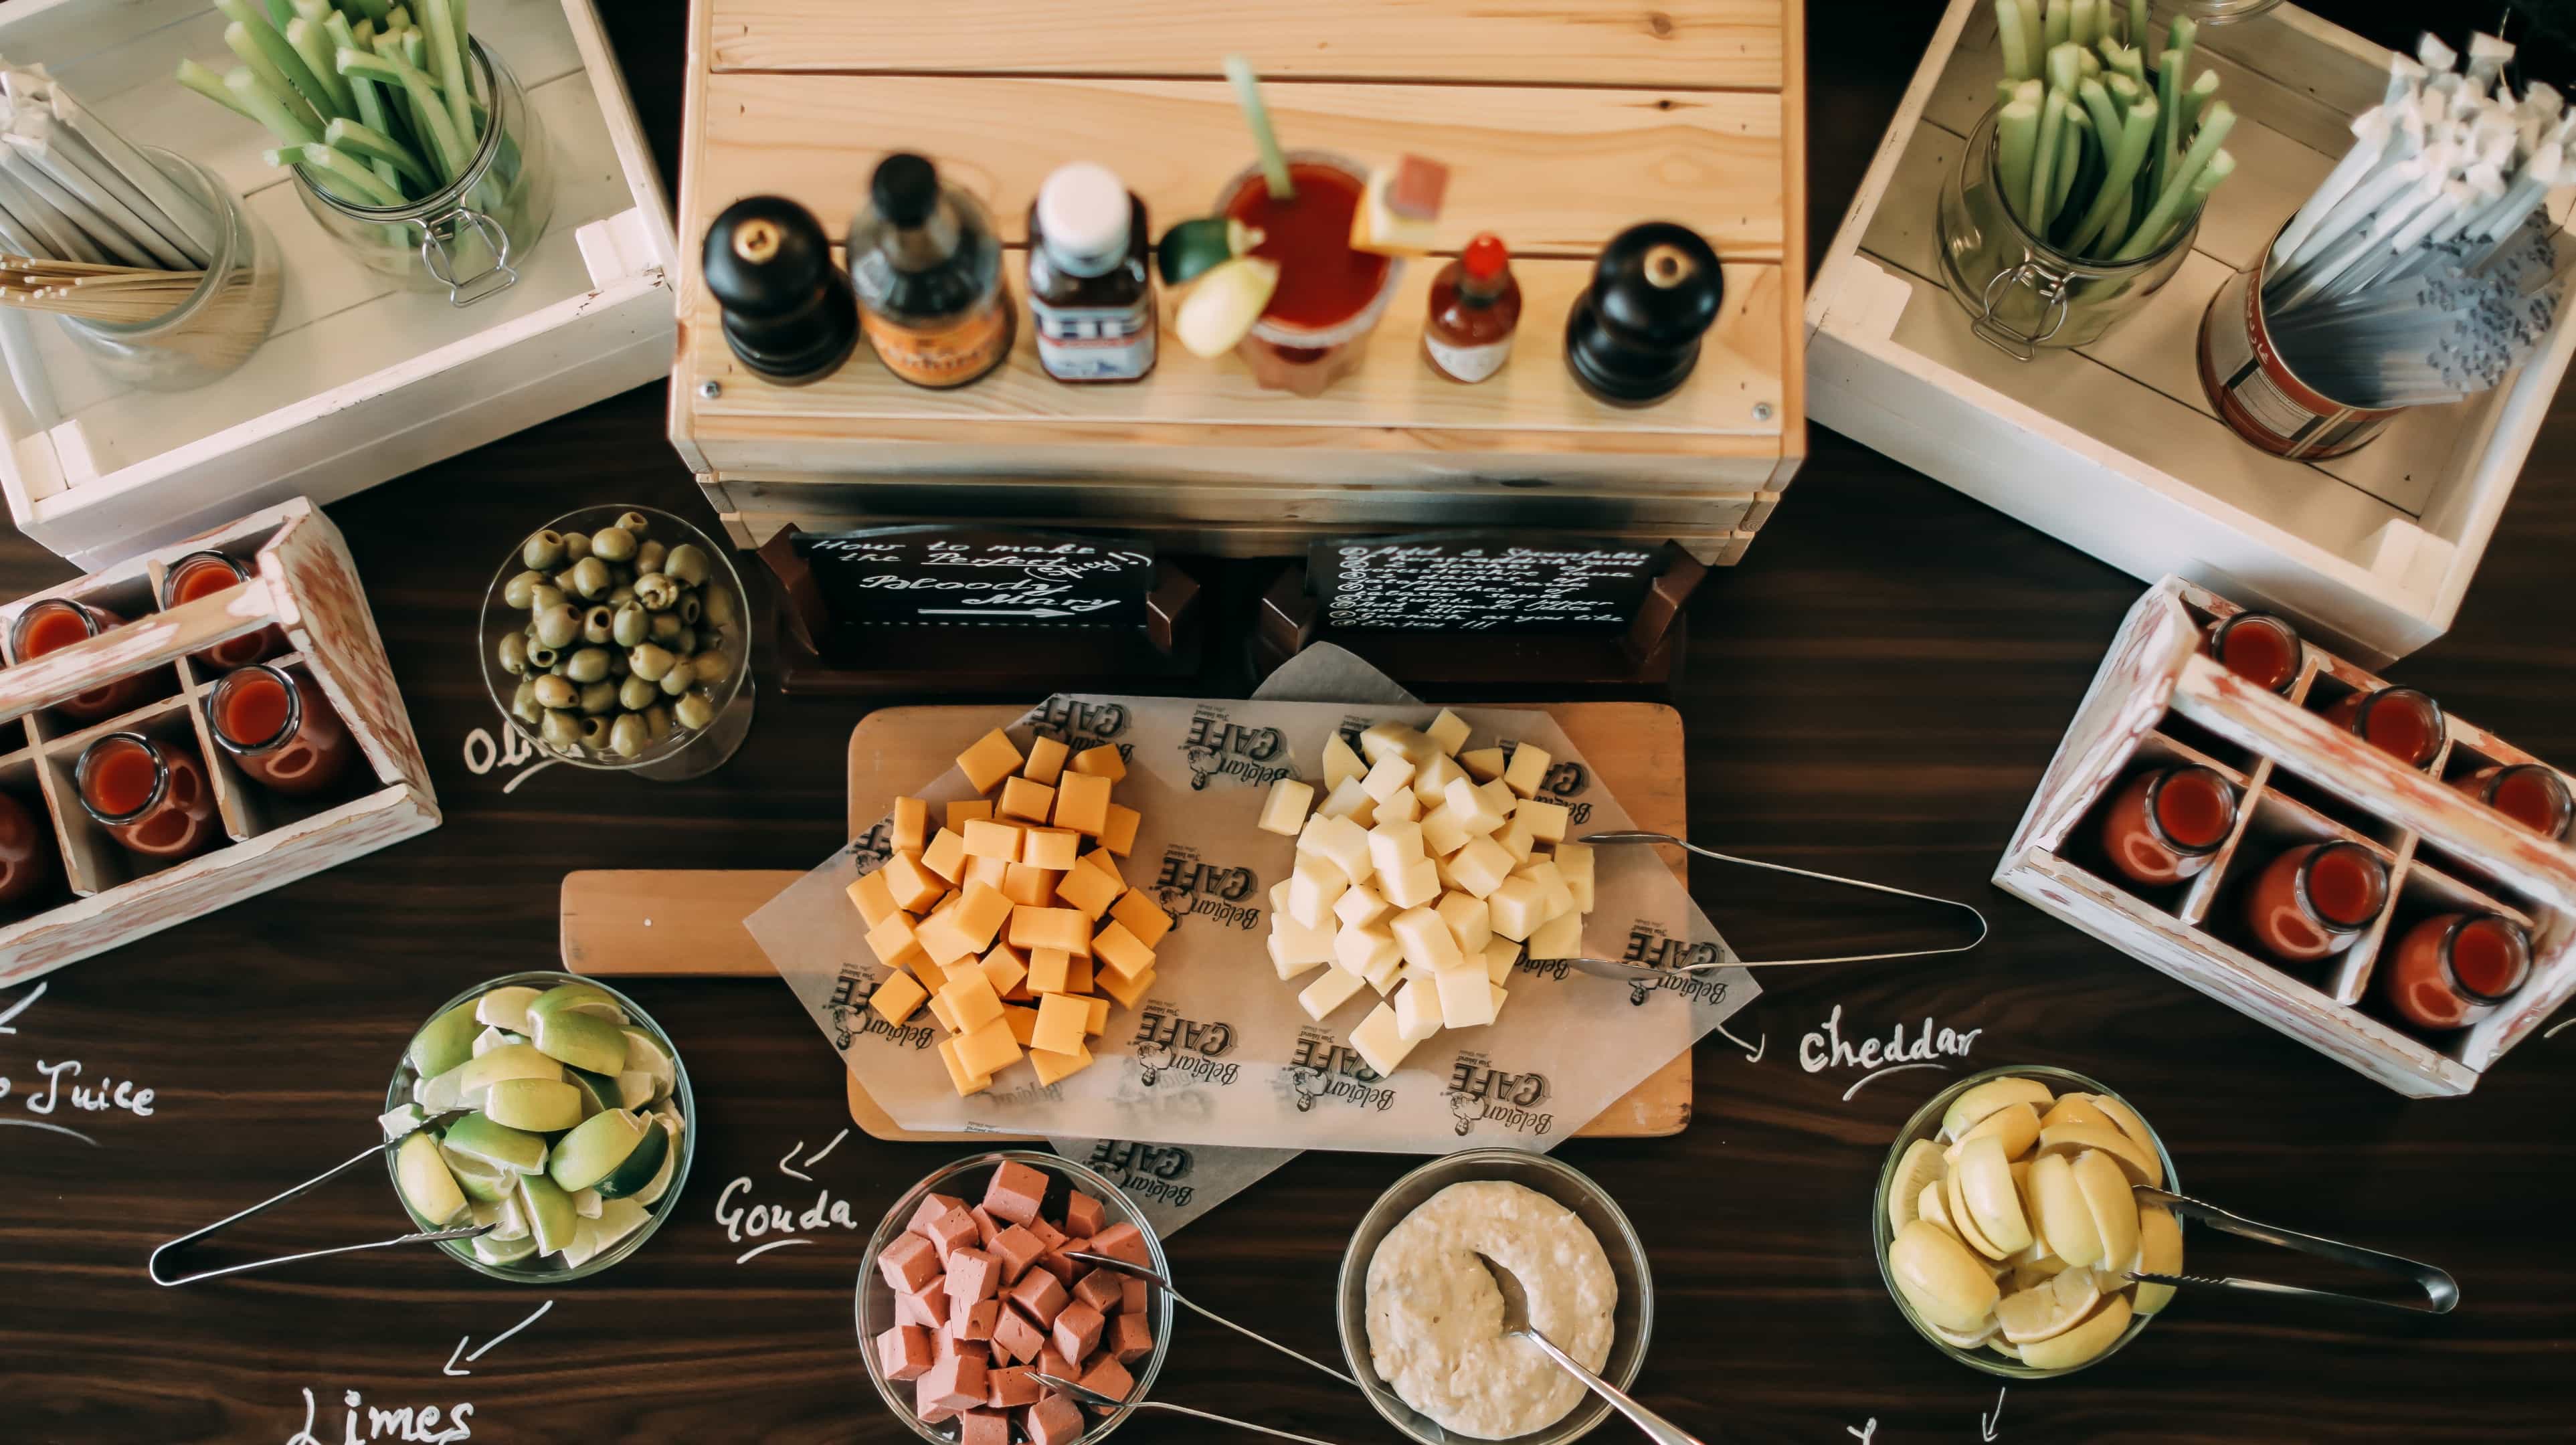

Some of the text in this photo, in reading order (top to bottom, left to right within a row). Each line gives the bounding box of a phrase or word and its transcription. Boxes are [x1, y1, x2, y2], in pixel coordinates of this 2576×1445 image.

[811, 540, 1096, 554] How to make
[838, 552, 1069, 567] the Perfect
[859, 575, 1074, 596] Bloody
[961, 593, 1121, 611] Mary
[1190, 898, 1261, 931] Belgian
[1513, 953, 1569, 981] Belgia
[1657, 975, 1728, 1006] Belgian
[864, 1017, 935, 1050] Belgian
[1170, 1053, 1240, 1086] Belgian
[26, 1059, 155, 1116] Juice
[1325, 1080, 1396, 1113] Belgian
[1482, 1104, 1554, 1136] Belgian
[1122, 1176, 1194, 1208] Belgian
[715, 1176, 858, 1242] Gouda
